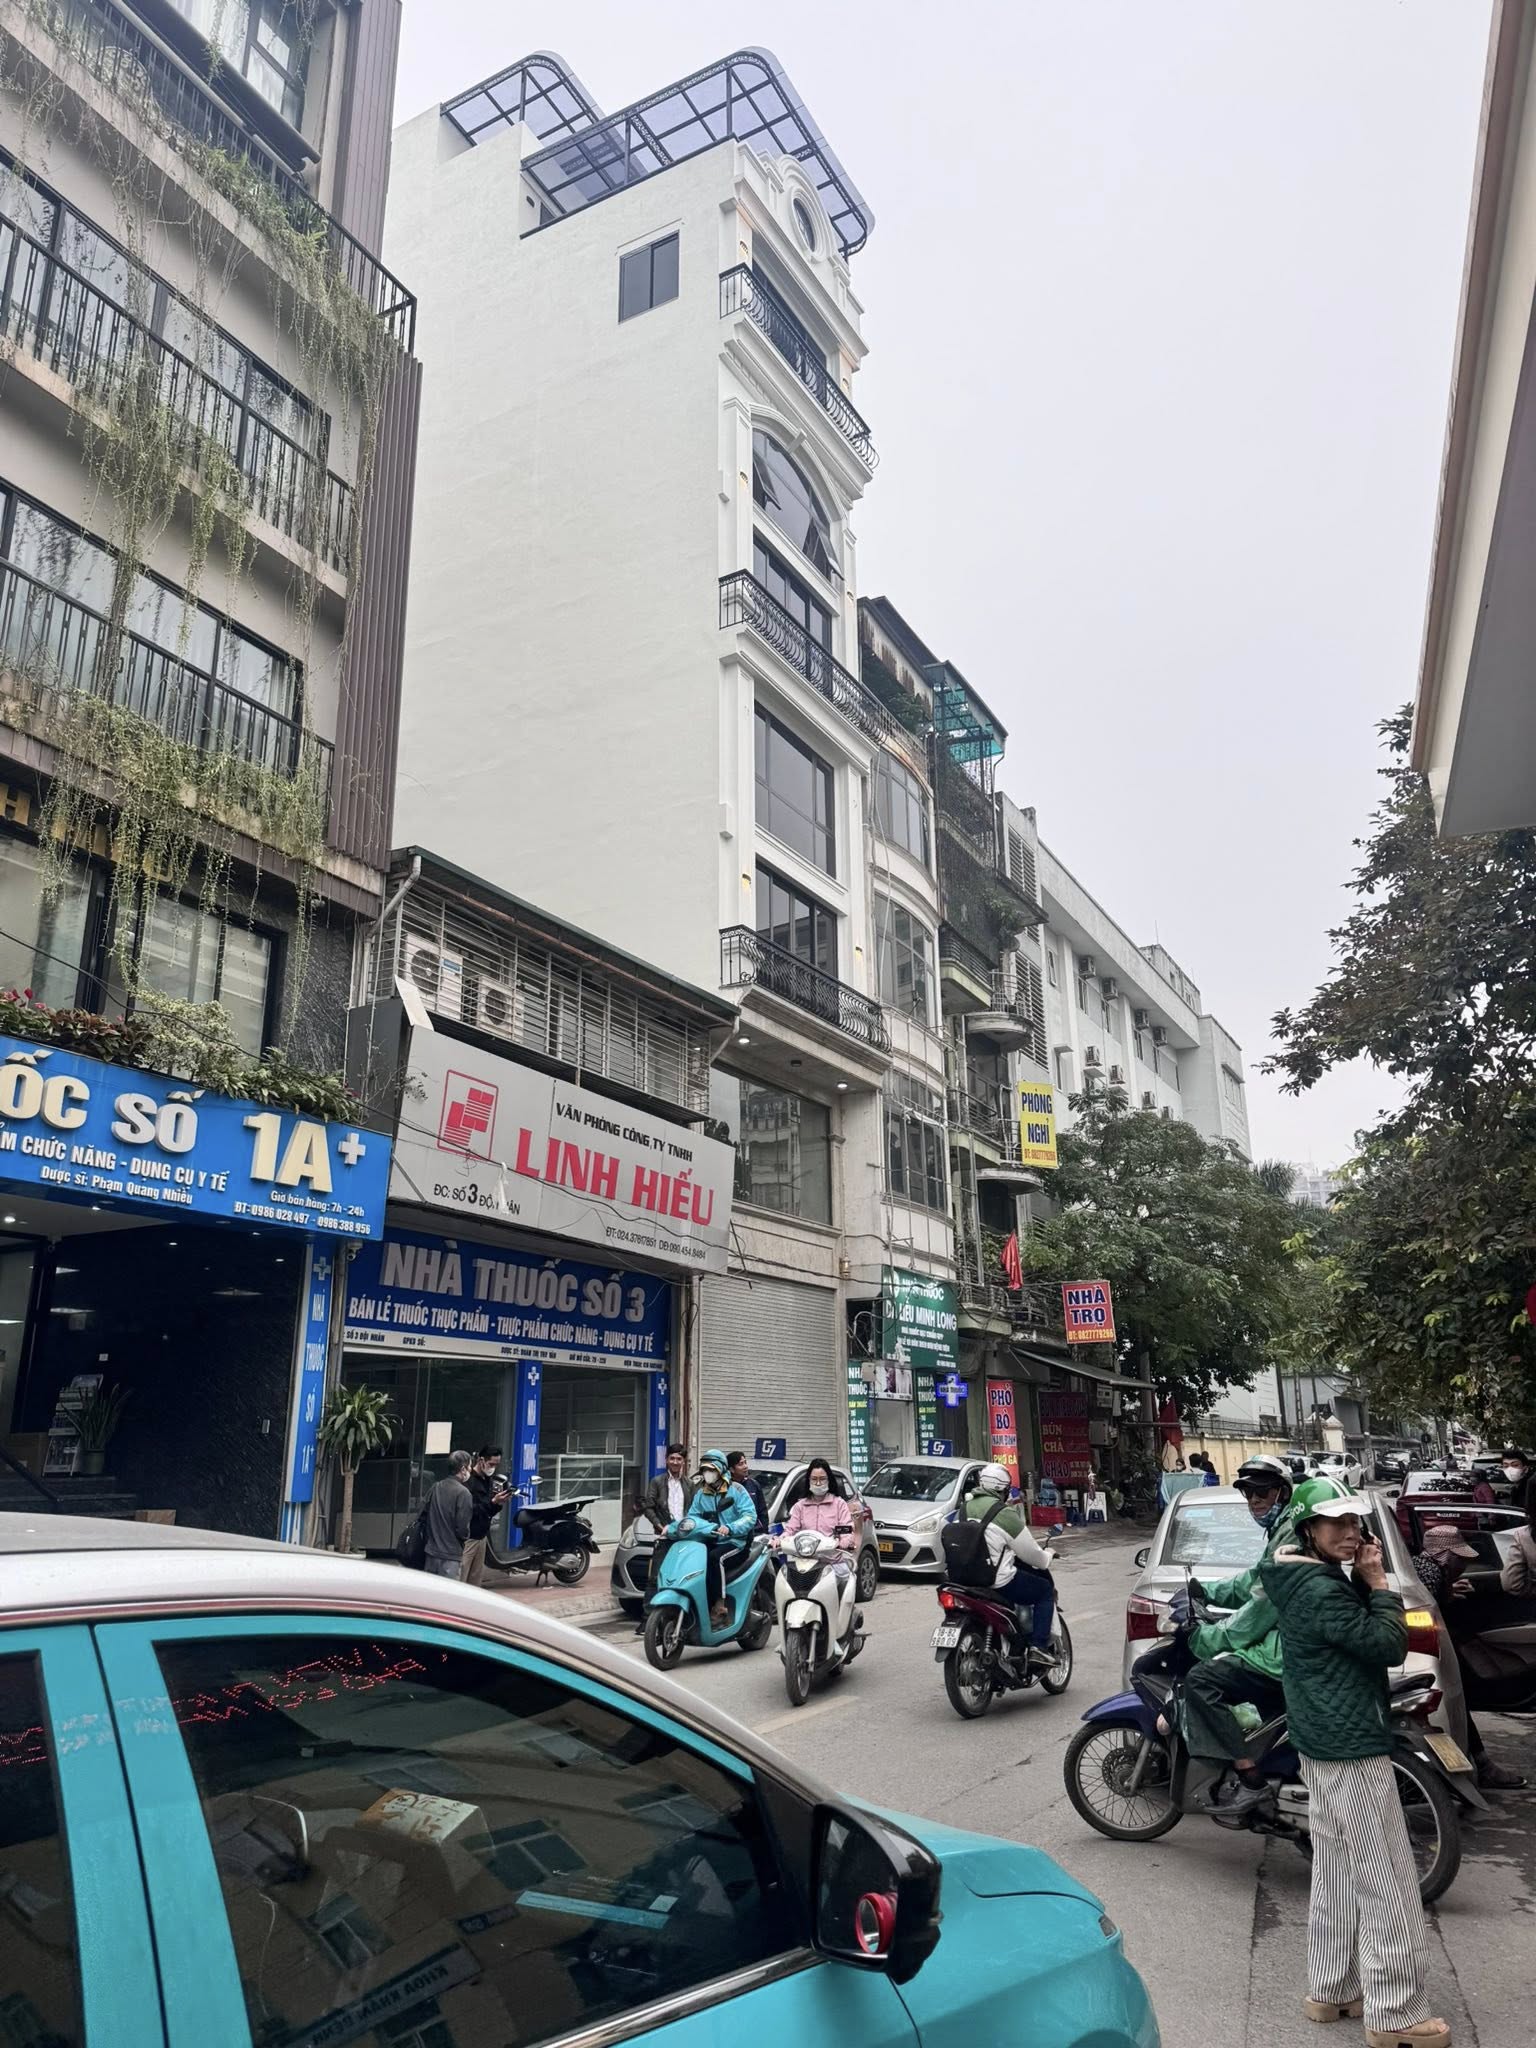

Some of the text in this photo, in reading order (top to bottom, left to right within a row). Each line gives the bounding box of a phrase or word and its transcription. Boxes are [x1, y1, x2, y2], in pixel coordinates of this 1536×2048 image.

[1021, 1088, 1053, 1114] PHÒNG
[111, 1089, 205, 1153] SỐ
[556, 1102, 693, 1162] VĂN PHÒNG CÔNG TY TNHH
[1027, 1117, 1050, 1144] NGHỈ
[21, 1136, 67, 1160] CHỨC
[71, 1144, 116, 1170] NĂNG
[129, 1157, 171, 1182] DỤNG
[174, 1166, 194, 1190] CỤ
[197, 1170, 208, 1188] Y
[210, 1170, 230, 1192] TẾ
[40, 1165, 71, 1184] Dược
[74, 1170, 88, 1186] sĩ:
[92, 1175, 123, 1193] Phạm
[126, 1182, 159, 1200] Quang
[516, 1127, 715, 1227] LINH HIẾU
[287, 1193, 304, 1206] bán
[331, 1202, 342, 1213] 7h
[348, 1205, 365, 1217] 24h
[434, 1183, 450, 1198] ĐC:
[452, 1186, 467, 1201] SỐ
[467, 1183, 478, 1204] 3
[251, 1204, 274, 1219] 0986
[275, 1208, 293, 1222] 028
[293, 1212, 310, 1225] 497
[317, 1216, 338, 1230] 0986
[355, 1222, 371, 1235] 956
[380, 1239, 646, 1322] NHÀ THUỐC SỐ 3
[311, 1288, 325, 1322] NHÀ
[1067, 1285, 1106, 1305] NHÀ
[349, 1294, 375, 1320] BÁN
[376, 1295, 391, 1322] LẺ
[393, 1299, 429, 1327] THUỐC
[431, 1307, 457, 1333] THỰC
[459, 1305, 490, 1334] PHẨM
[497, 1315, 521, 1340] THỰC
[522, 1313, 550, 1340] PHẨM
[550, 1321, 574, 1343] CHỨC
[574, 1323, 598, 1347] NĂNG
[603, 1330, 625, 1351] DỤNG
[626, 1334, 637, 1354] CỤ
[637, 1335, 644, 1351] Y
[644, 1332, 655, 1353] TẾ
[915, 1306, 935, 1328] MINH
[936, 1310, 957, 1331] LONG
[1070, 1308, 1106, 1326] TRỌ
[918, 1375, 935, 1387] NHÀ
[991, 1383, 1012, 1406] PHỞ
[995, 1408, 1010, 1430] BÒ
[1042, 1421, 1063, 1436] BÚN
[762, 1440, 777, 1457] G7
[932, 1441, 945, 1455] G7
